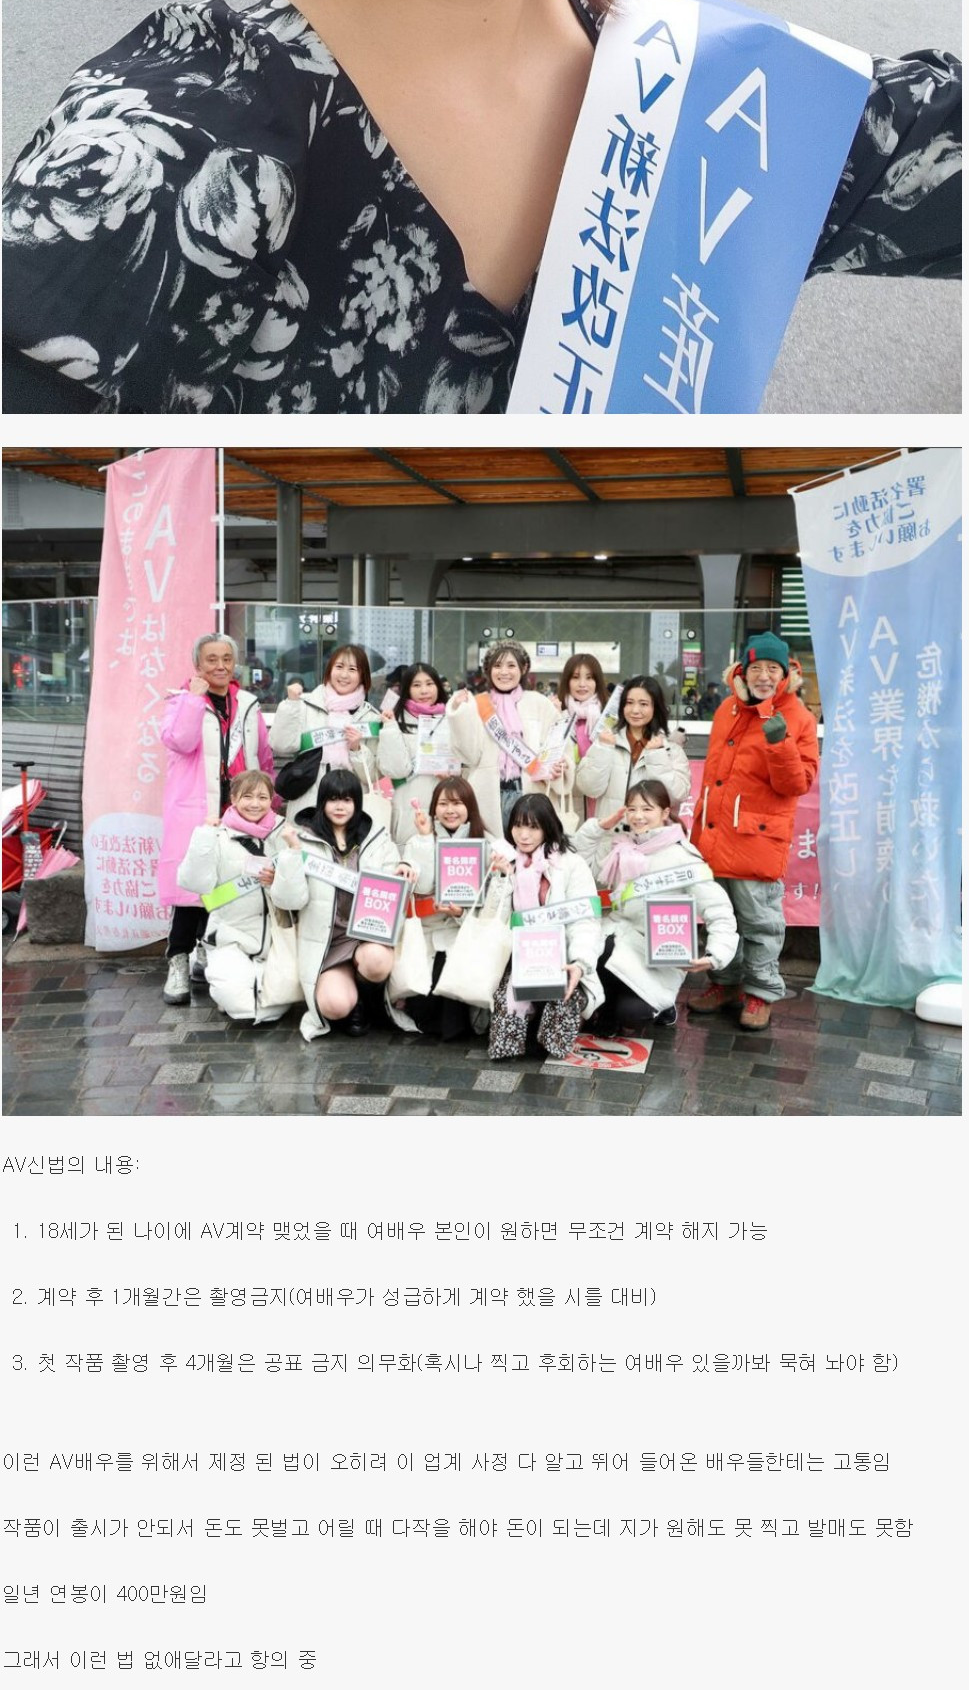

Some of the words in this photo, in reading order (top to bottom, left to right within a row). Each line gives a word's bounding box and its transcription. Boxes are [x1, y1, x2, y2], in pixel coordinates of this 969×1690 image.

[447, 866, 474, 877] BOX
[364, 897, 391, 912] BOX
[656, 924, 686, 936] BOX
